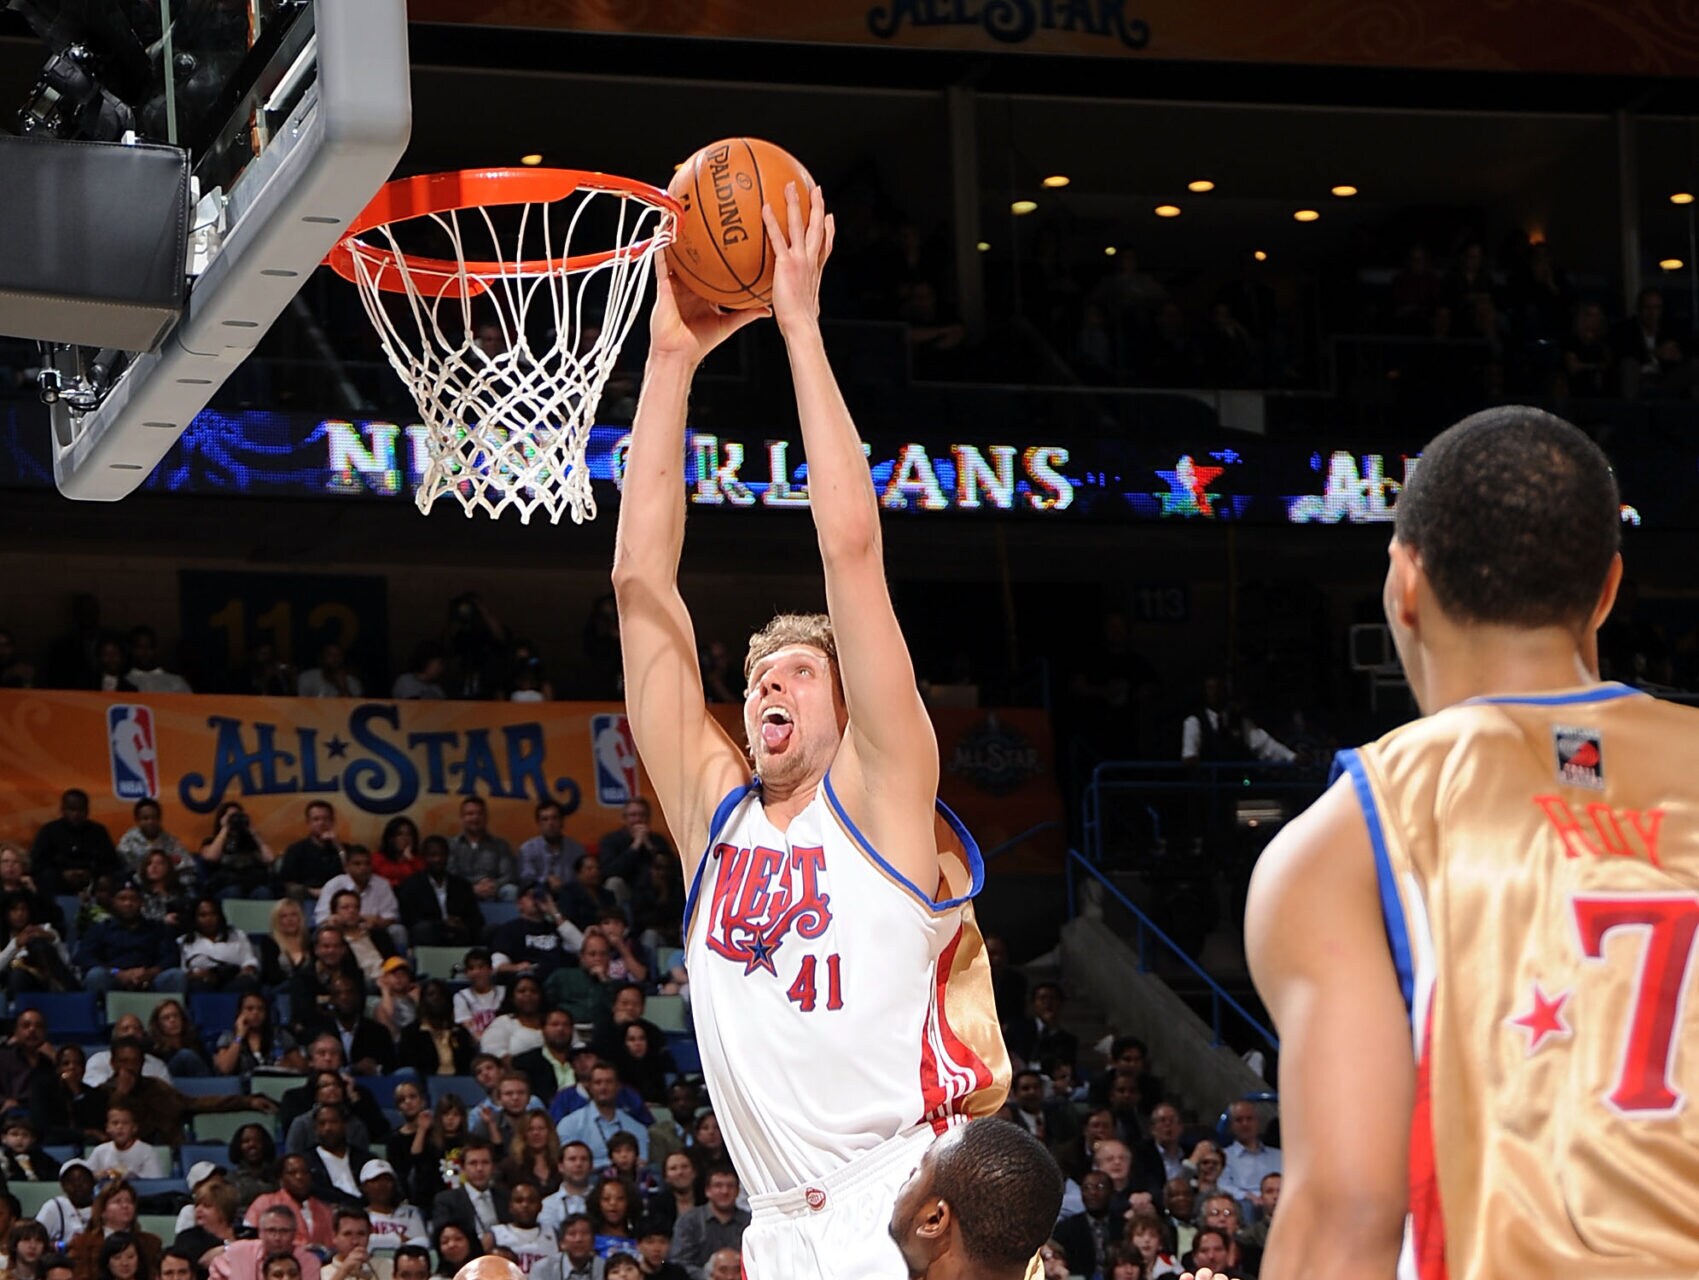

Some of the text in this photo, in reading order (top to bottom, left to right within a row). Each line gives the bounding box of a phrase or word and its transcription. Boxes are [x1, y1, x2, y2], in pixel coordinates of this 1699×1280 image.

[704, 145, 749, 247] SPALDING
[612, 433, 1075, 510] RLANS
[178, 703, 582, 816] ALL STAR
[1532, 794, 1666, 869] ROY
[706, 842, 833, 962] WEST
[786, 953, 844, 1012] 41
[1566, 890, 1699, 1120] 7
